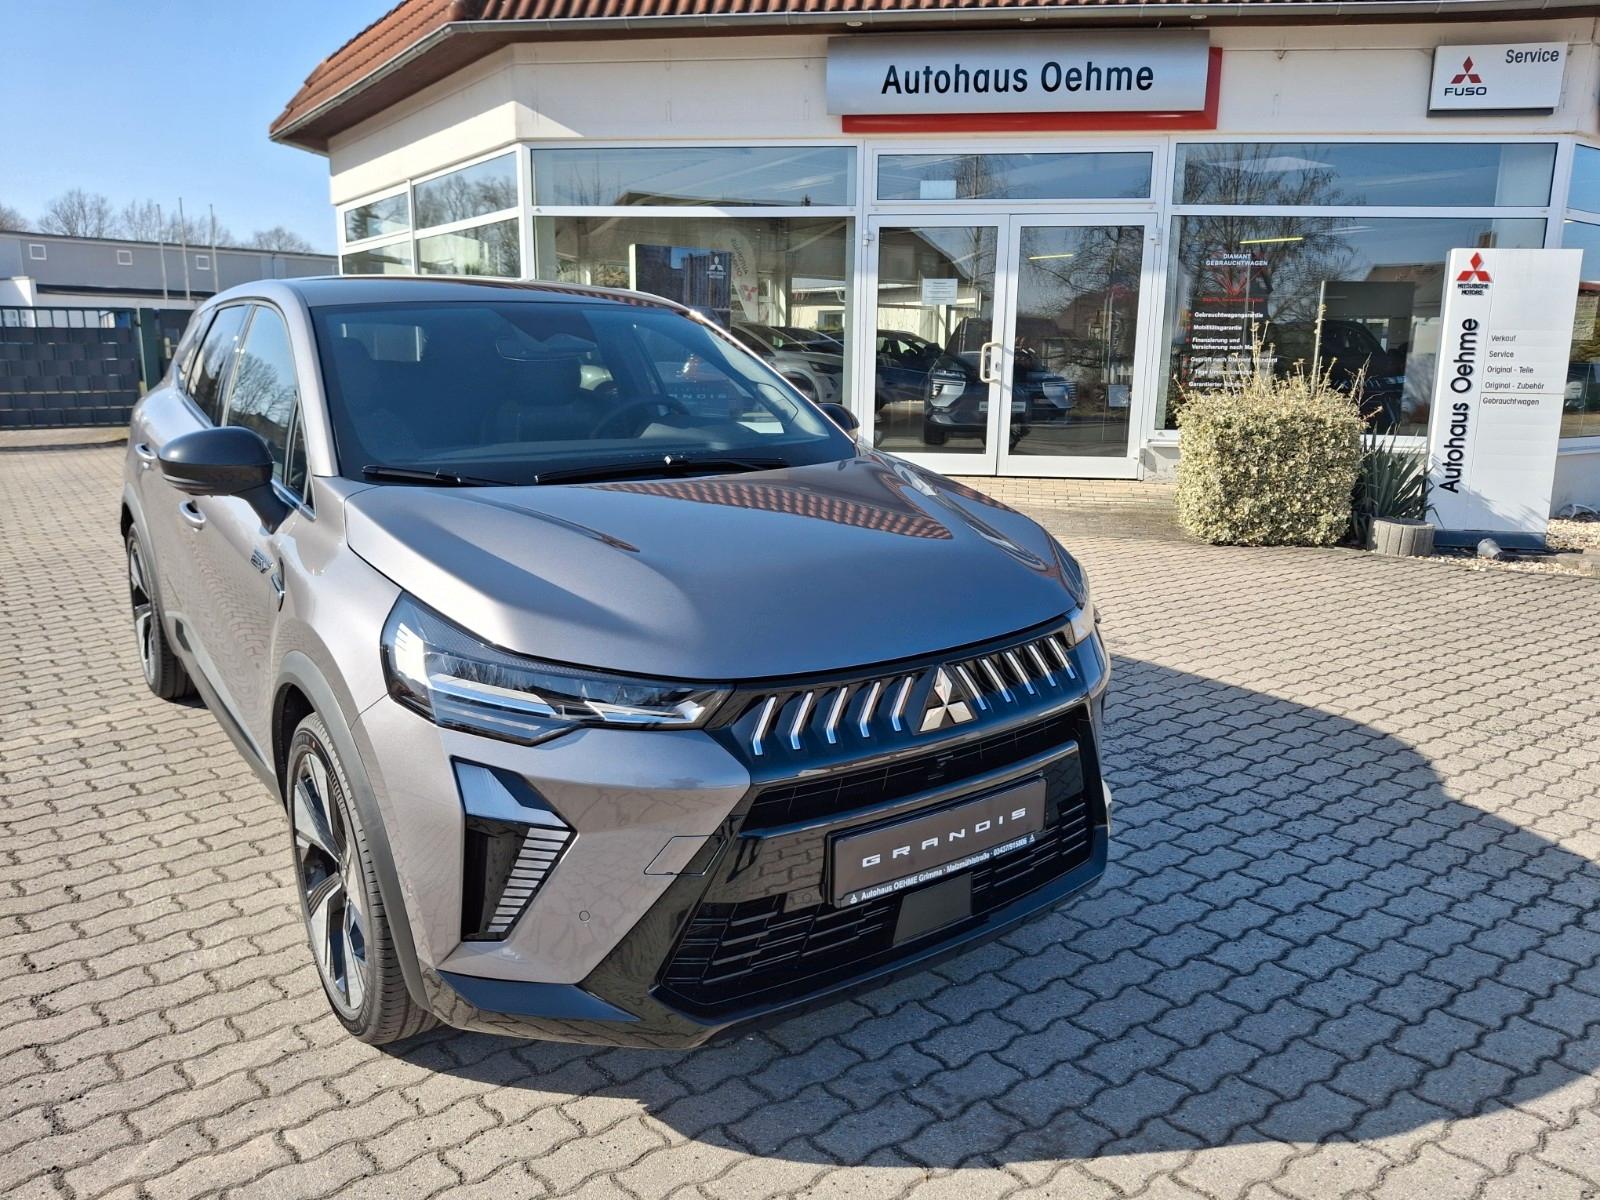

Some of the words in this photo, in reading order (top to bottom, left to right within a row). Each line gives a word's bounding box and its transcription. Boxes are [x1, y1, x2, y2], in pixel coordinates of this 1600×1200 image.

[1505, 48, 1560, 64] Service
[881, 63, 1028, 94] Autohaus
[1040, 61, 1154, 93] Oehme
[1444, 87, 1487, 97] FUSO
[1450, 318, 1479, 394] Oehme
[1489, 350, 1515, 358] Service
[1487, 366, 1513, 374] Original
[1485, 382, 1511, 390] Original
[1516, 382, 1544, 390] Zubehör
[1482, 397, 1540, 406] Gebrauchtwagen
[1438, 402, 1470, 494] Autohaus
[862, 807, 1026, 868] GRANDIS
[861, 885, 892, 900] Autohaus
[893, 875, 918, 890] OEHME
[918, 869, 943, 882] Grimma
